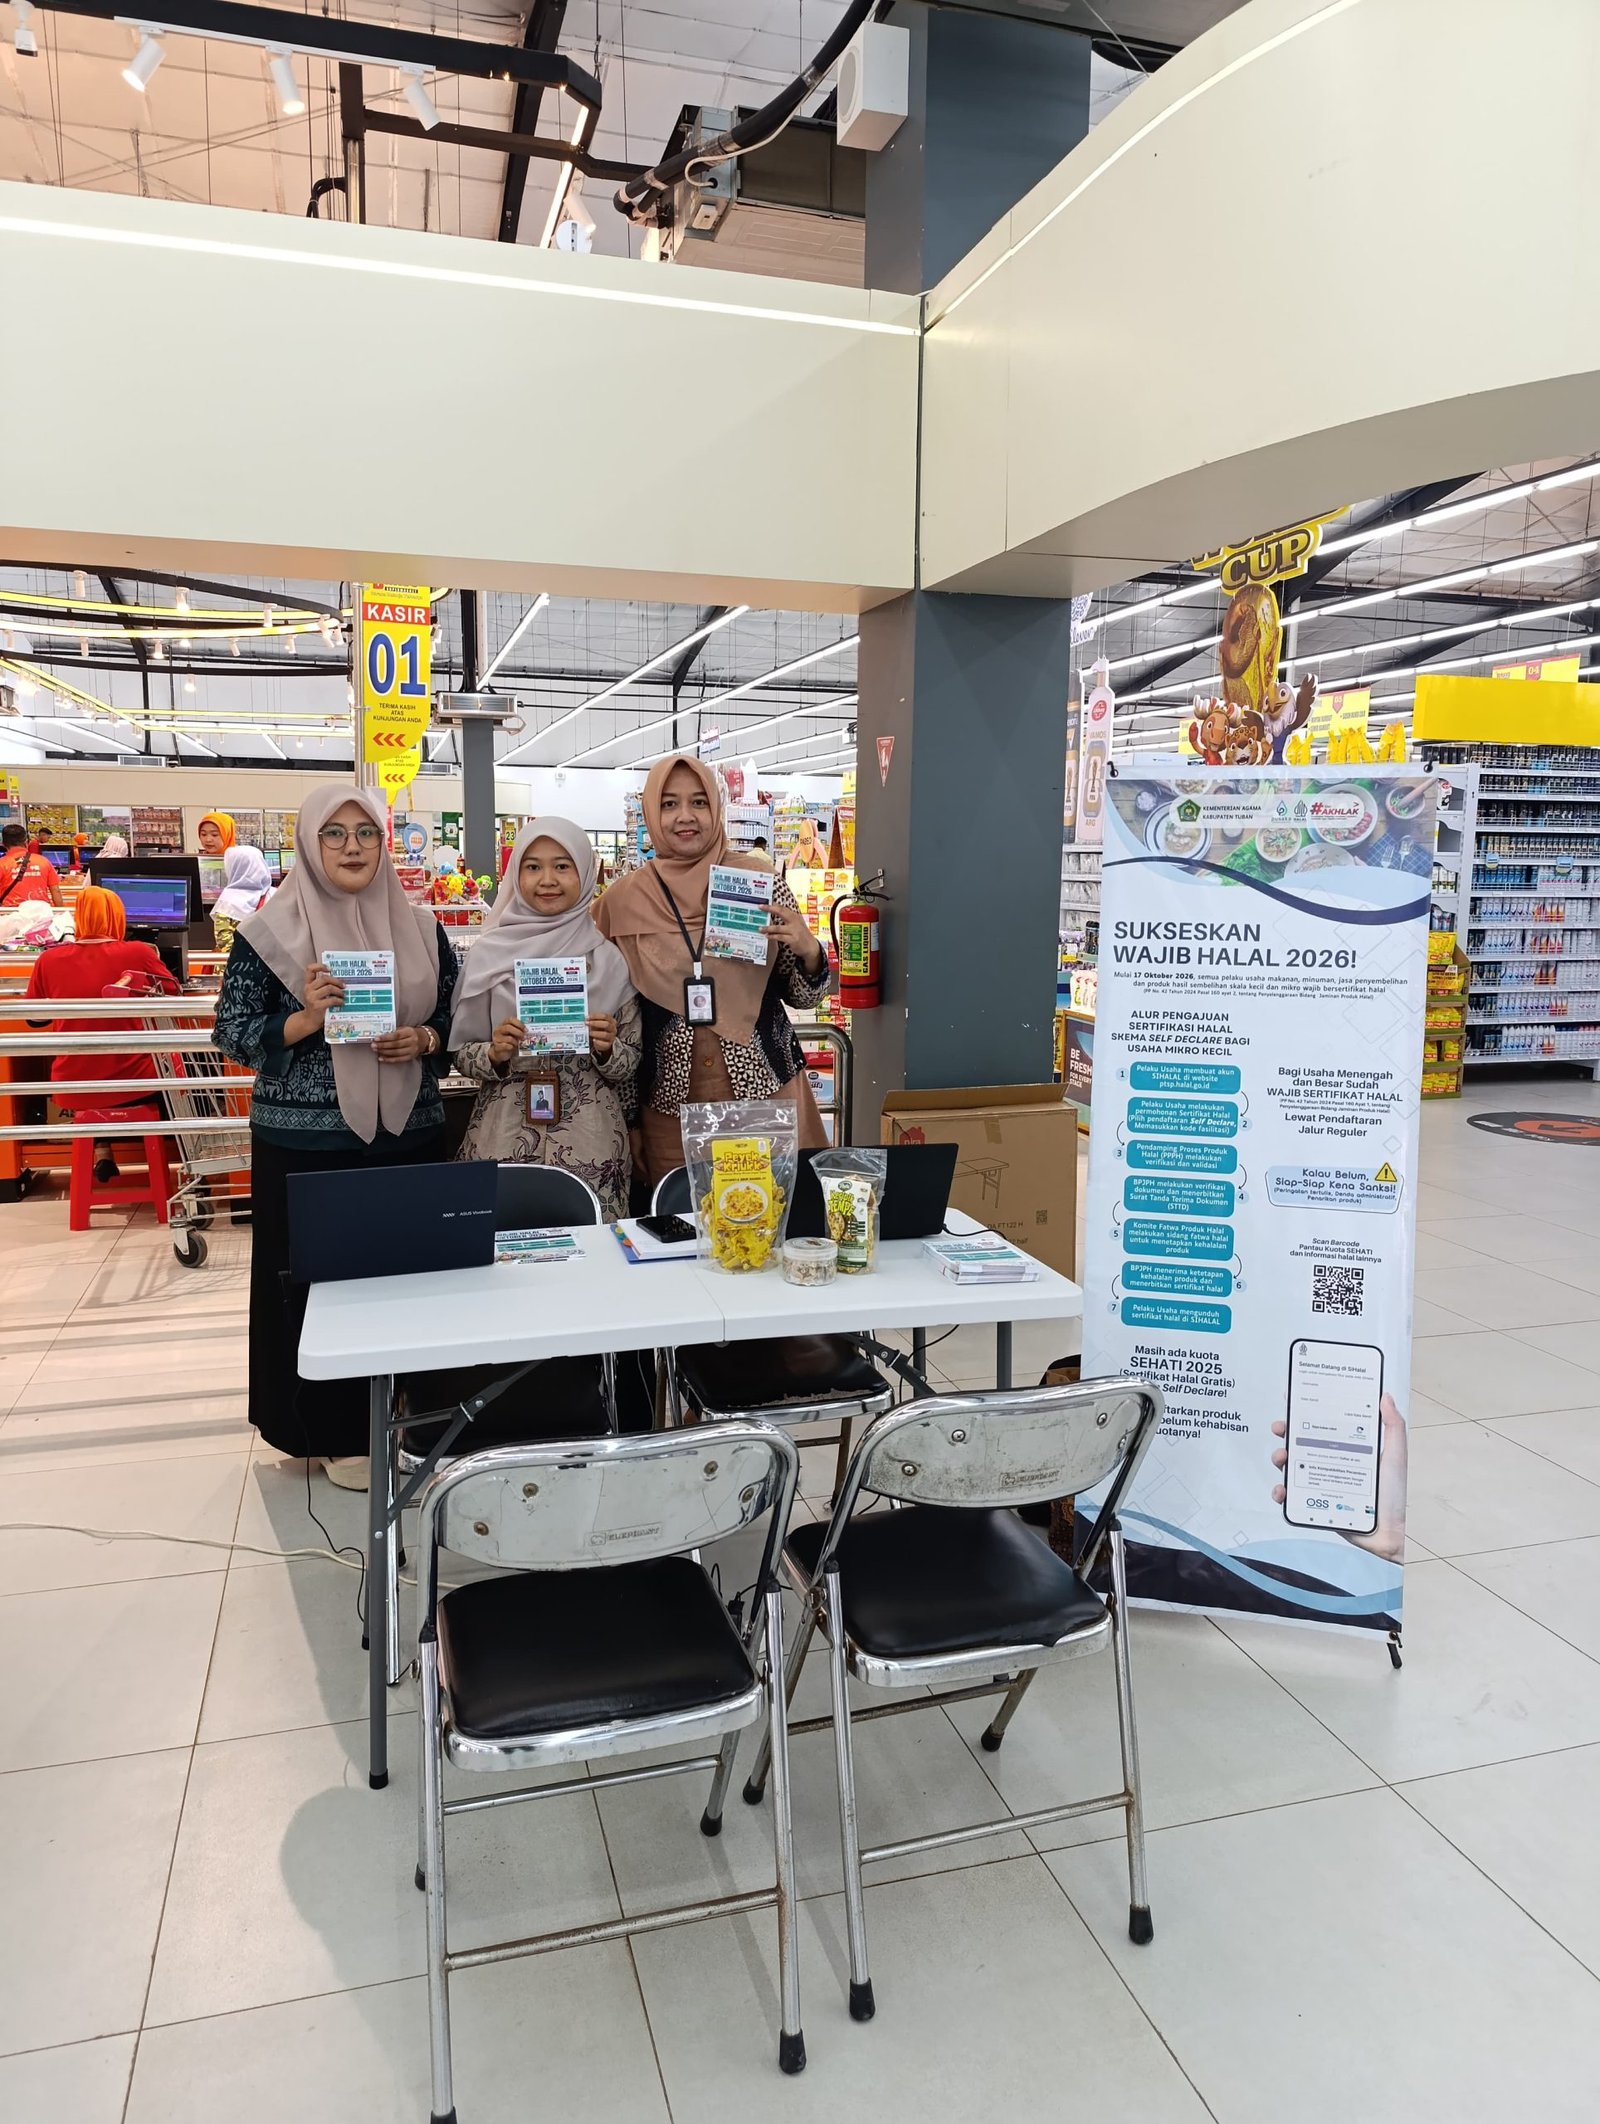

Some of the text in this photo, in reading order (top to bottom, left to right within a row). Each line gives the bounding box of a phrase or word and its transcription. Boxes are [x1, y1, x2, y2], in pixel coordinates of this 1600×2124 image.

[1222, 529, 1310, 590] CUP
[368, 604, 426, 623] KASIR
[368, 633, 426, 696] 01
[506, 832, 514, 840] 23
[714, 874, 748, 885] WAJIB HALAL
[714, 883, 736, 893] OKTOBER
[1114, 921, 1261, 942] SUKSESKAN
[1113, 945, 1357, 968] WAJIB HALAL 2026!
[541, 967, 559, 975] HALAL
[521, 977, 546, 985] OKTOBER
[1131, 1010, 1229, 1021] ALUR PENGAJUAN
[1129, 1022, 1233, 1033] SERTIFIKASI HALAL
[1111, 1033, 1146, 1041] SKEMA
[1149, 1034, 1172, 1042] SELF
[1175, 1035, 1222, 1044] DECLARE
[1071, 1048, 1080, 1060] BE
[1128, 1044, 1232, 1056] USAHA MIKRO KECIL
[1070, 1060, 1092, 1076] FRESH
[1184, 1067, 1215, 1075] membuat
[1279, 1067, 1393, 1081] Bagi Usaha Menengah
[1160, 1081, 1210, 1090] ptsp.halal.go.id
[1293, 1078, 1379, 1089] dan Besar Sudah
[1267, 1088, 1403, 1102] WAJIB SERTIFIKAT HALAL
[1188, 1102, 1224, 1111] melakukan
[1135, 1108, 1178, 1117] permohonan
[1179, 1110, 1210, 1118] Sertifikat
[1285, 1113, 1382, 1125] Lewat Pendaftaran
[1148, 1116, 1188, 1125] pendaftaran
[1208, 1118, 1236, 1127] Declare,
[1135, 1122, 1230, 1134] Memasukkan kode fasilitasi)
[1298, 1125, 1367, 1138] Jalur Reguler
[1302, 1168, 1369, 1181] Kalau Belum,
[1276, 1177, 1396, 1193] Siap-Siap Kena Sanksi!
[1325, 1245, 1345, 1253] Kuota
[1306, 1251, 1336, 1259] informasi
[1356, 1255, 1381, 1263] lainnya
[1133, 1304, 1154, 1312] Pelaku
[1180, 1308, 1219, 1317] mengunduh
[1132, 1312, 1161, 1320] sertifikat
[1164, 1314, 1180, 1322] halal
[1190, 1316, 1220, 1325] SIHALAL
[1135, 1345, 1220, 1361] Masih ada kuota
[1130, 1356, 1223, 1375] SEHATI 2025
[1172, 1374, 1198, 1384] Halal
[1201, 1377, 1236, 1388] Gratis)
[1162, 1384, 1227, 1397] Self Declare!
[1202, 1408, 1241, 1421] produk
[1194, 1419, 1249, 1433] kehabisan
[1307, 1498, 1329, 1508] OSS
